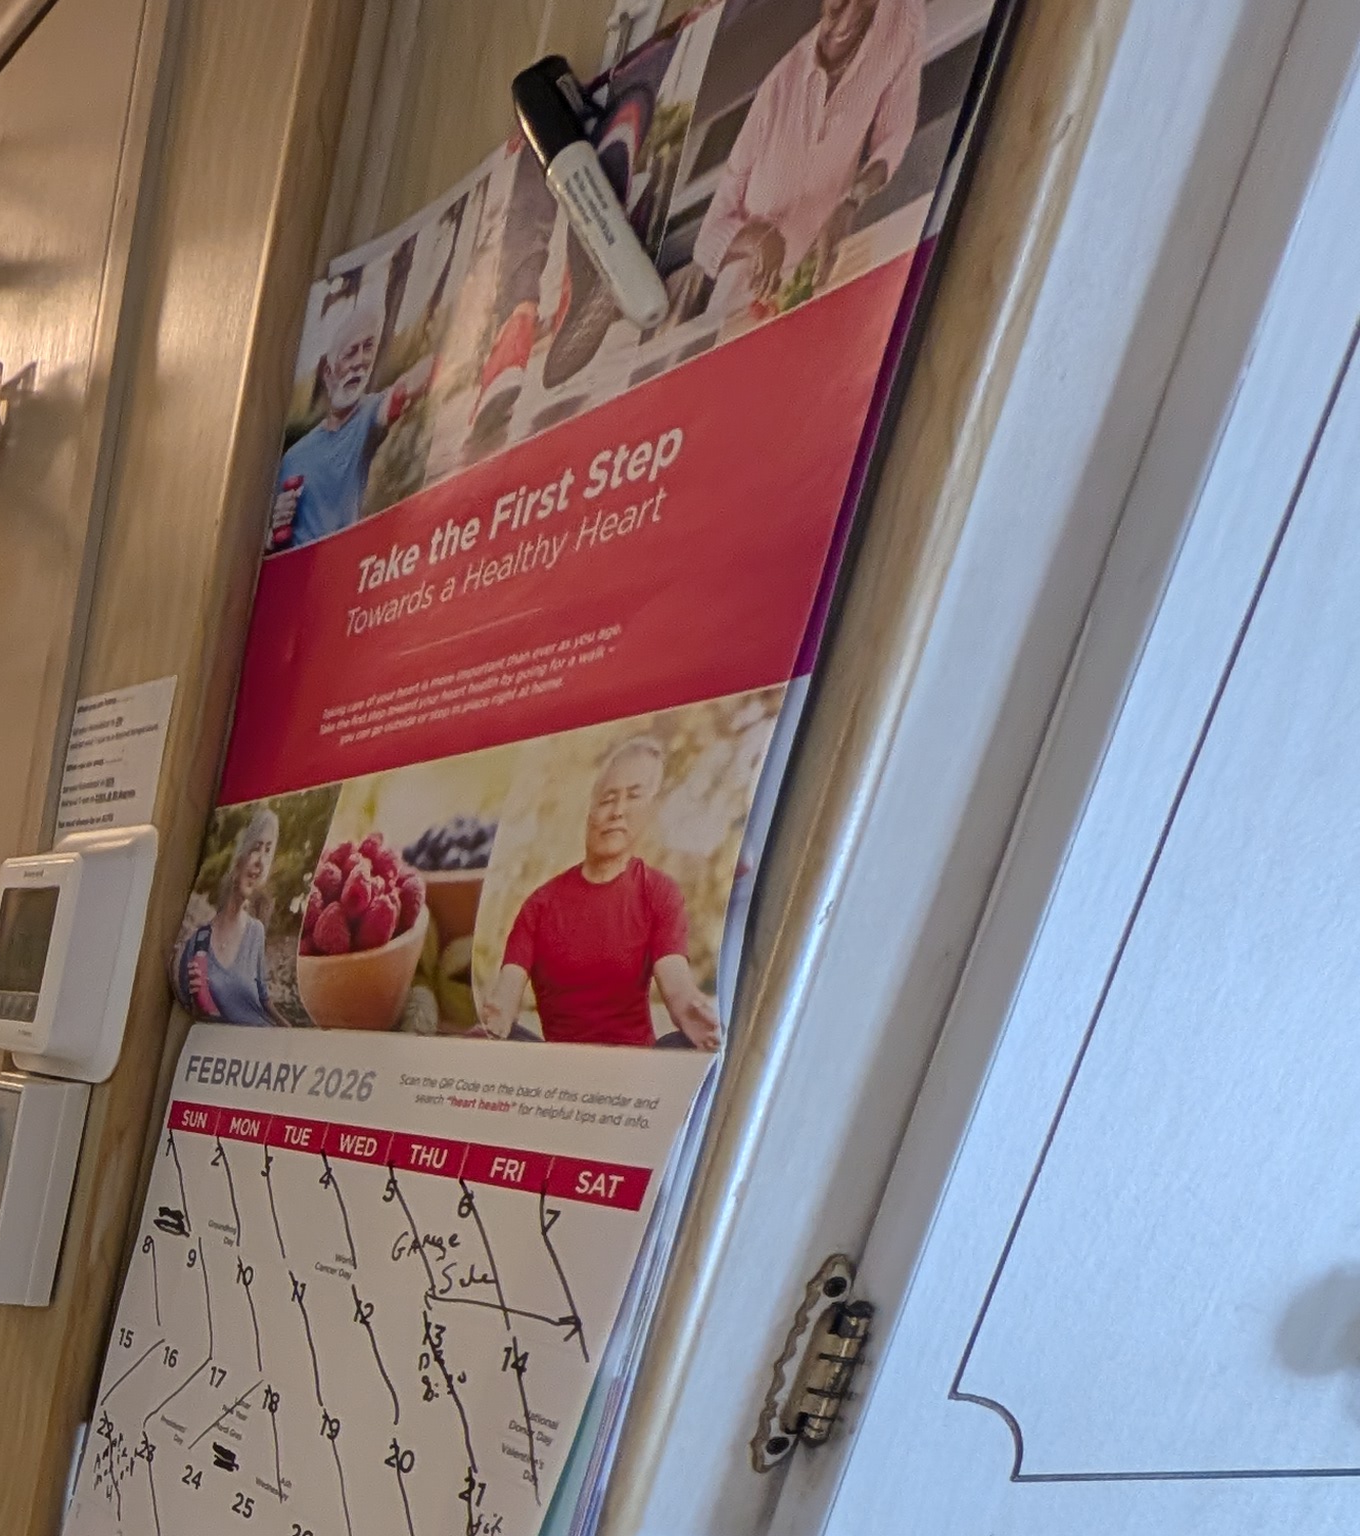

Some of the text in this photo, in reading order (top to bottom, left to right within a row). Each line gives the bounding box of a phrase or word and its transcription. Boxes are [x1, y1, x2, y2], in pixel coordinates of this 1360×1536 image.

[357, 427, 684, 594] Take the First Step
[347, 488, 668, 637] Towards a Healthy Heart
[185, 1055, 377, 1102] FEBRUARY 2026
[399, 1074, 660, 1110] Scan the QR Code on the back of this calendar and
[415, 1094, 445, 1105] search
[518, 1103, 534, 1115] for
[535, 1105, 575, 1120] helpful
[575, 1110, 597, 1124] tips
[599, 1114, 623, 1126] and
[182, 1110, 625, 1199] SUN MON TUE WED THU FRI SAT
[211, 1146, 224, 1166] 2
[319, 1167, 333, 1190] 4
[382, 1178, 398, 1202] 5
[457, 1190, 474, 1219] 6
[543, 1209, 561, 1236] 7
[142, 1235, 529, 1373] 8 9 10 11 12 13 14
[314, 1261, 352, 1281] Cancer Day
[119, 1328, 134, 1349] 15
[162, 1346, 179, 1368] 16
[209, 1366, 227, 1389] 17
[262, 1388, 280, 1414] 18
[320, 1412, 340, 1440] 19
[384, 1443, 415, 1474] 20
[458, 1475, 486, 1508] 21
[508, 1419, 553, 1446] Donr Day
[137, 1440, 156, 1463] 23
[182, 1464, 202, 1490] 24
[232, 1492, 254, 1518] 25
